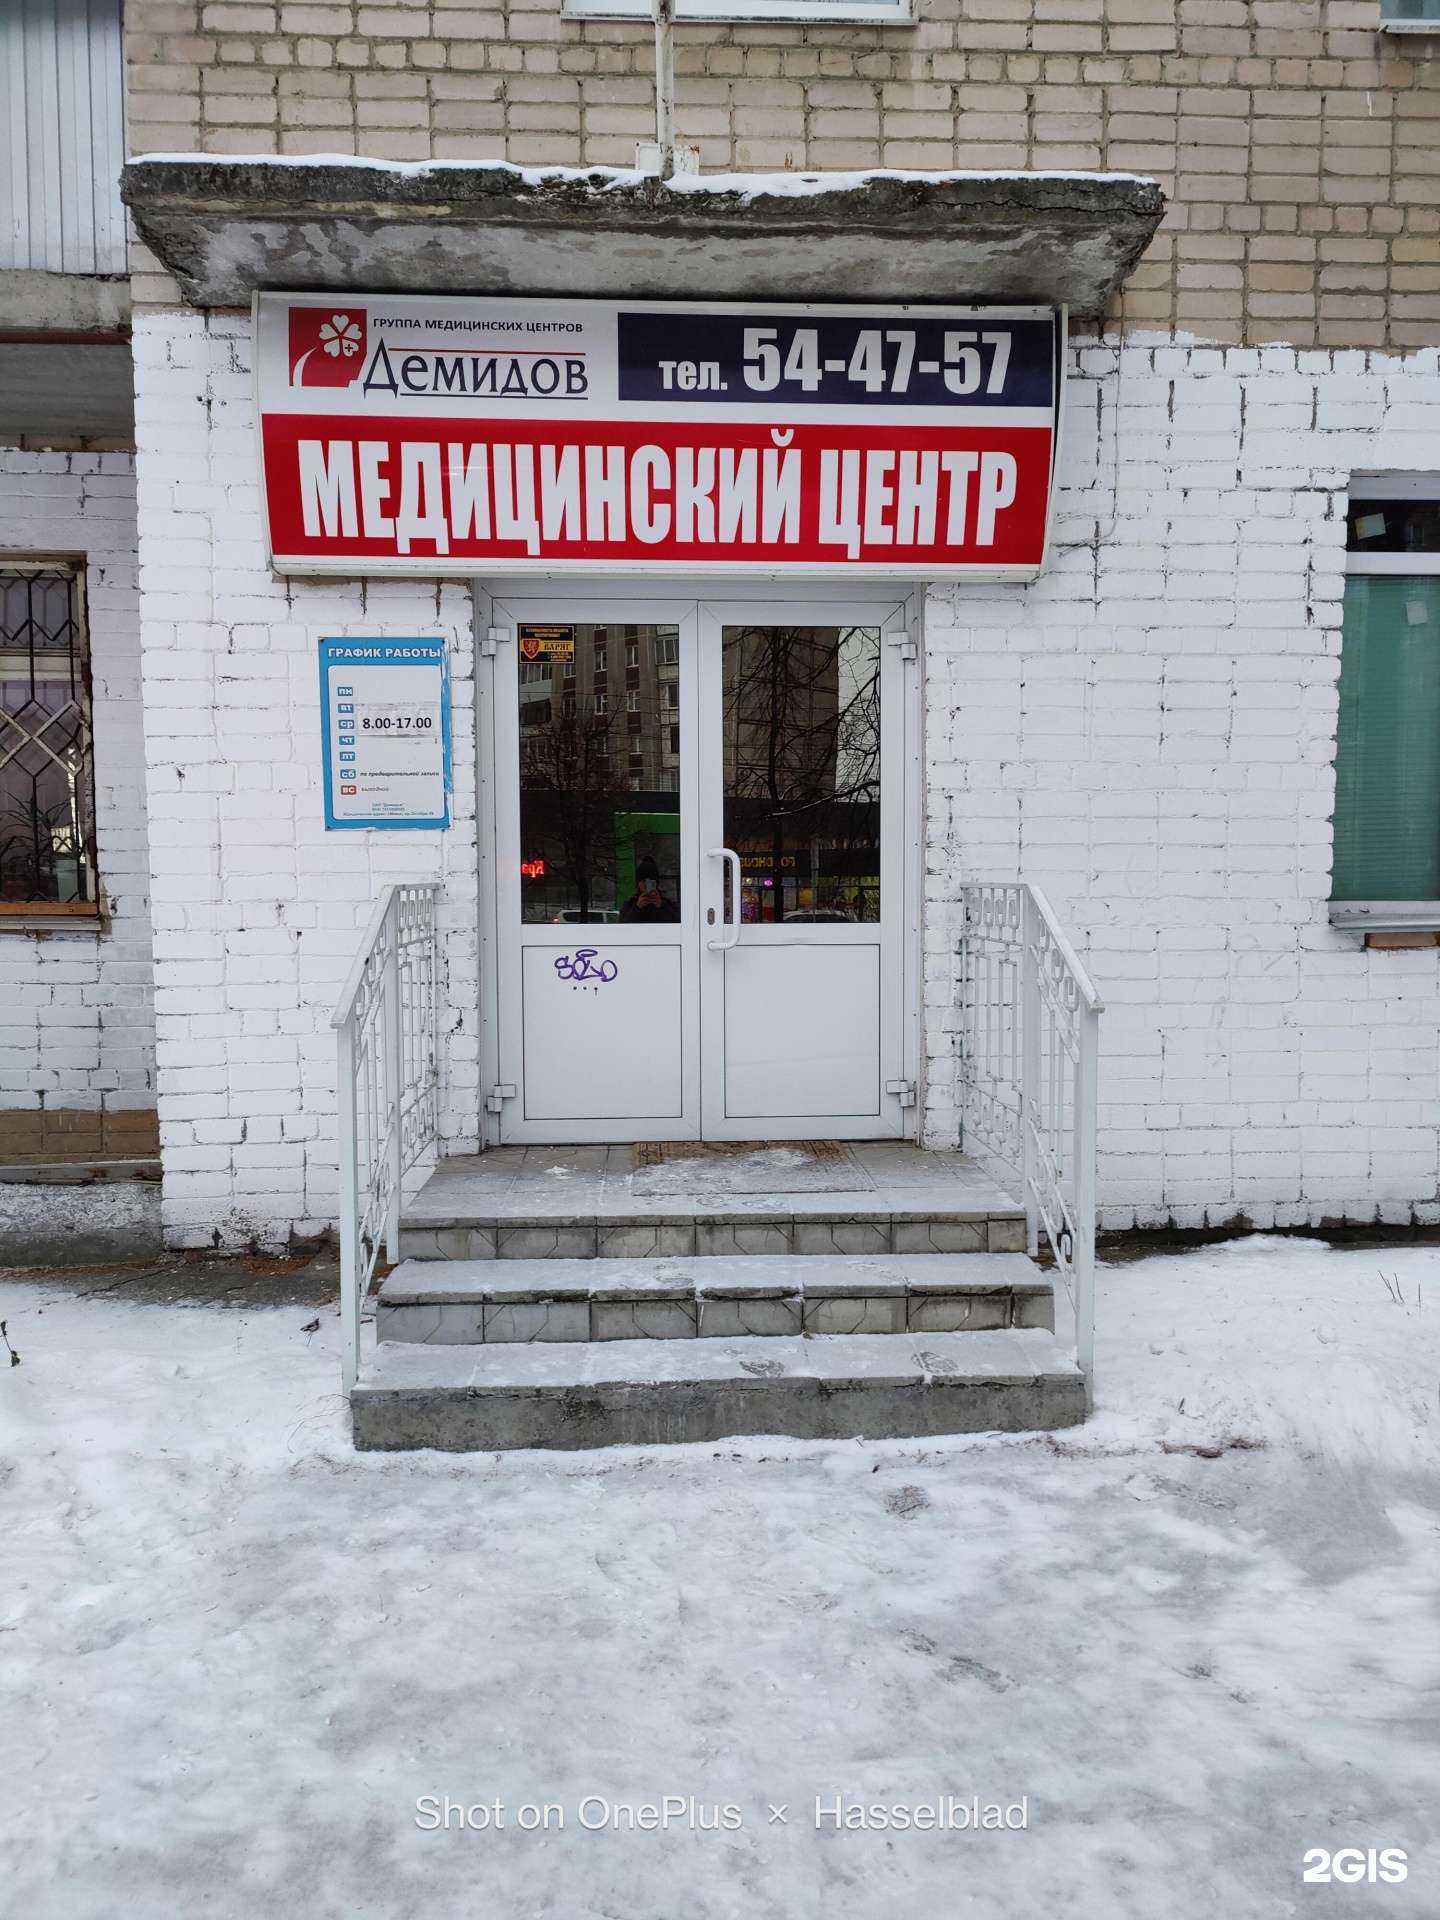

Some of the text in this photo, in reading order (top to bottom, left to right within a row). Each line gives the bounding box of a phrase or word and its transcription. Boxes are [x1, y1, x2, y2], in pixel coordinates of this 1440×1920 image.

[373, 318, 583, 334] ГРУППА МЕДИЦИНСКИХ ЦЕНТРОВ
[658, 327, 1012, 395] тел. 54-47-57
[298, 428, 1018, 560] МЕДИЦИНСКИЙ ЦЕНТР
[328, 648, 441, 658] ГРАФИК РАБОТЫ
[362, 717, 432, 729] 8.00-17.00
